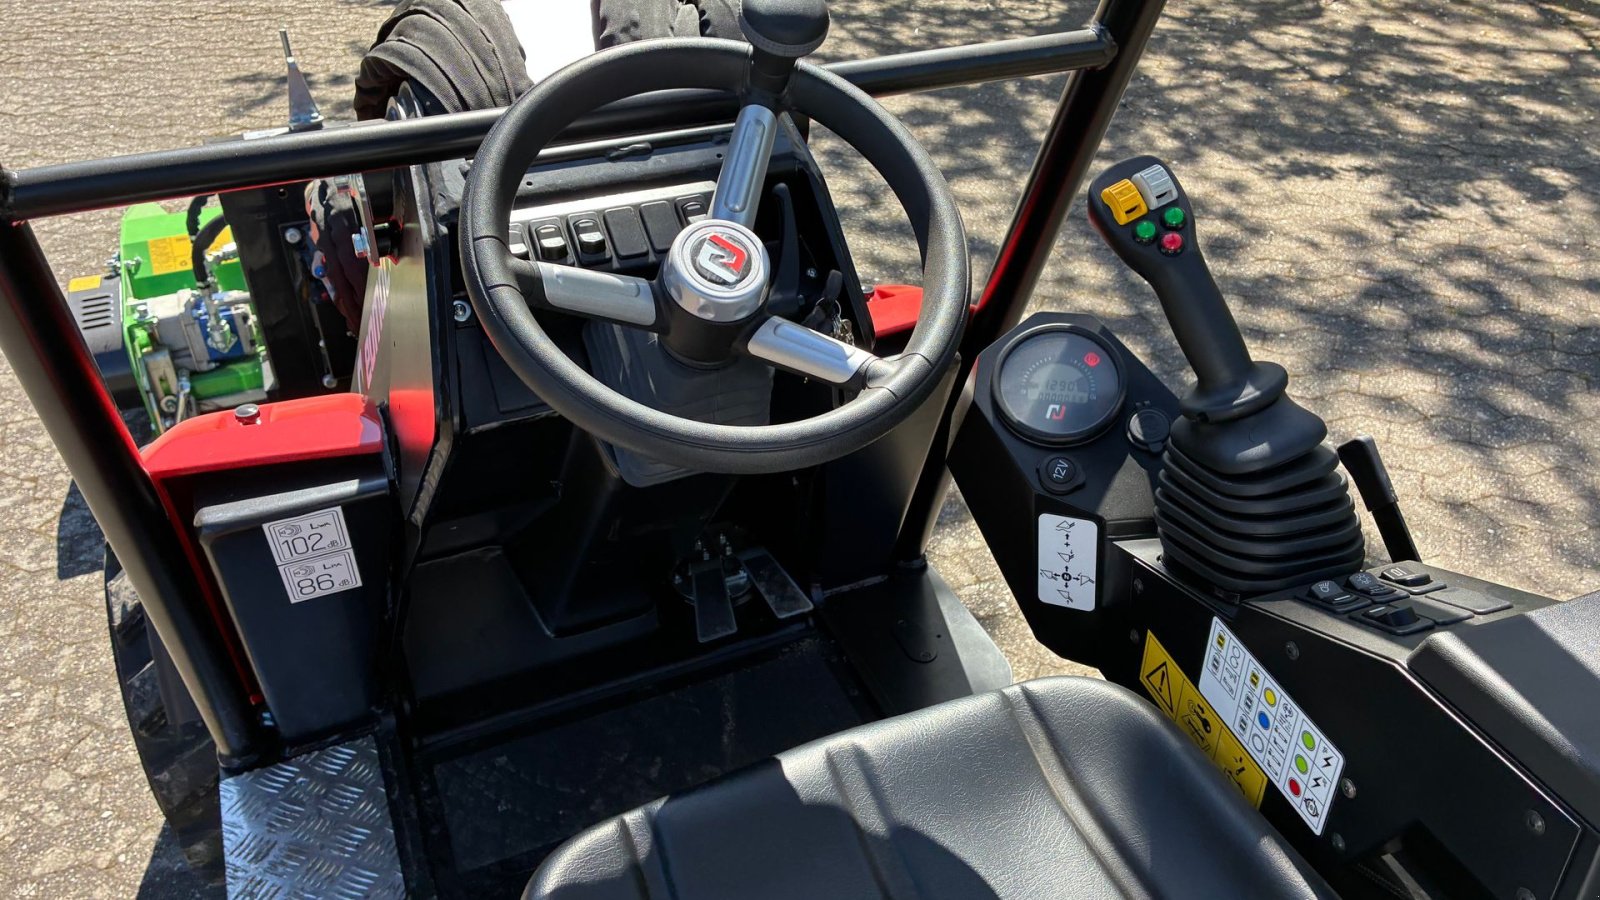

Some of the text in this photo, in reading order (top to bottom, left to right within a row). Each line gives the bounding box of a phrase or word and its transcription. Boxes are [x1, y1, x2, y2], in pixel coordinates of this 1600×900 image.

[1047, 379, 1075, 392] 1290
[1053, 459, 1069, 480] 12V
[281, 532, 340, 557] 102 dB
[297, 573, 350, 596] 86 dB
